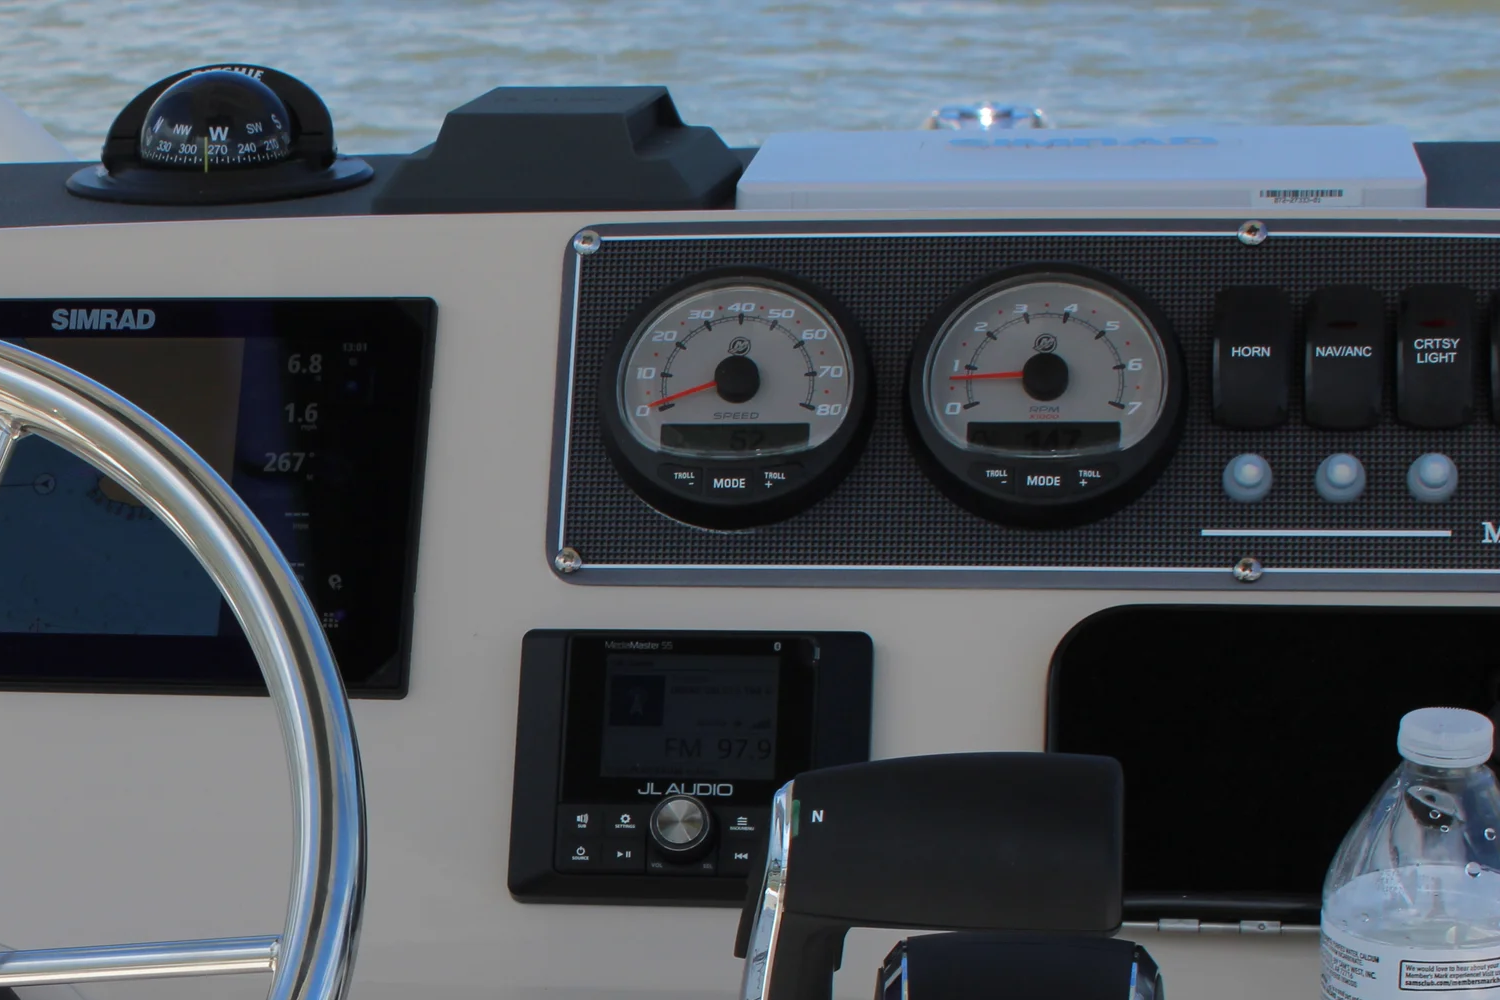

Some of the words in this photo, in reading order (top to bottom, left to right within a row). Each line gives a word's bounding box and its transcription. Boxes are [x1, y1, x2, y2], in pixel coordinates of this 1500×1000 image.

[172, 123, 192, 136] NW
[208, 126, 229, 141] W
[245, 122, 263, 134] SW
[271, 113, 282, 130] S
[156, 140, 172, 152] 330
[178, 143, 198, 154] 300
[207, 145, 228, 154] 270
[237, 142, 257, 154] 240
[263, 138, 279, 151] 210
[727, 302, 755, 312] 40
[1013, 304, 1028, 314] 3
[1064, 303, 1078, 314] 4
[51, 308, 156, 330] SIMRAD
[688, 309, 715, 320] 30
[768, 308, 796, 319] 50
[974, 322, 989, 332] 2
[1105, 320, 1120, 331] 5
[652, 330, 678, 342] 20
[802, 329, 828, 340] 60
[1414, 338, 1460, 350] CRTSY
[1231, 346, 1271, 358] HORN
[1315, 346, 1372, 358] NAV/ANC
[1416, 352, 1457, 364] LIGHT
[287, 353, 323, 374] 6.8
[1127, 358, 1143, 370] 6
[636, 367, 656, 380] 10
[818, 366, 844, 378] 70
[284, 403, 319, 423] 1.6
[635, 405, 649, 417] 0
[815, 404, 842, 416] 80
[944, 402, 962, 415] 0
[1029, 405, 1060, 413] RPM
[1127, 402, 1142, 415] 7
[712, 412, 760, 420] SPEED
[674, 472, 695, 480] TROLL
[764, 472, 786, 480] TROLL
[986, 470, 1008, 478] TROLL
[1078, 470, 1101, 478] TROLL
[713, 478, 746, 488] MODE
[1026, 476, 1061, 486] MODE
[665, 738, 702, 757] FM
[717, 738, 772, 760] 97.9
[638, 782, 662, 796] JL
[665, 783, 734, 796] AUDIO
[811, 810, 824, 823] N
